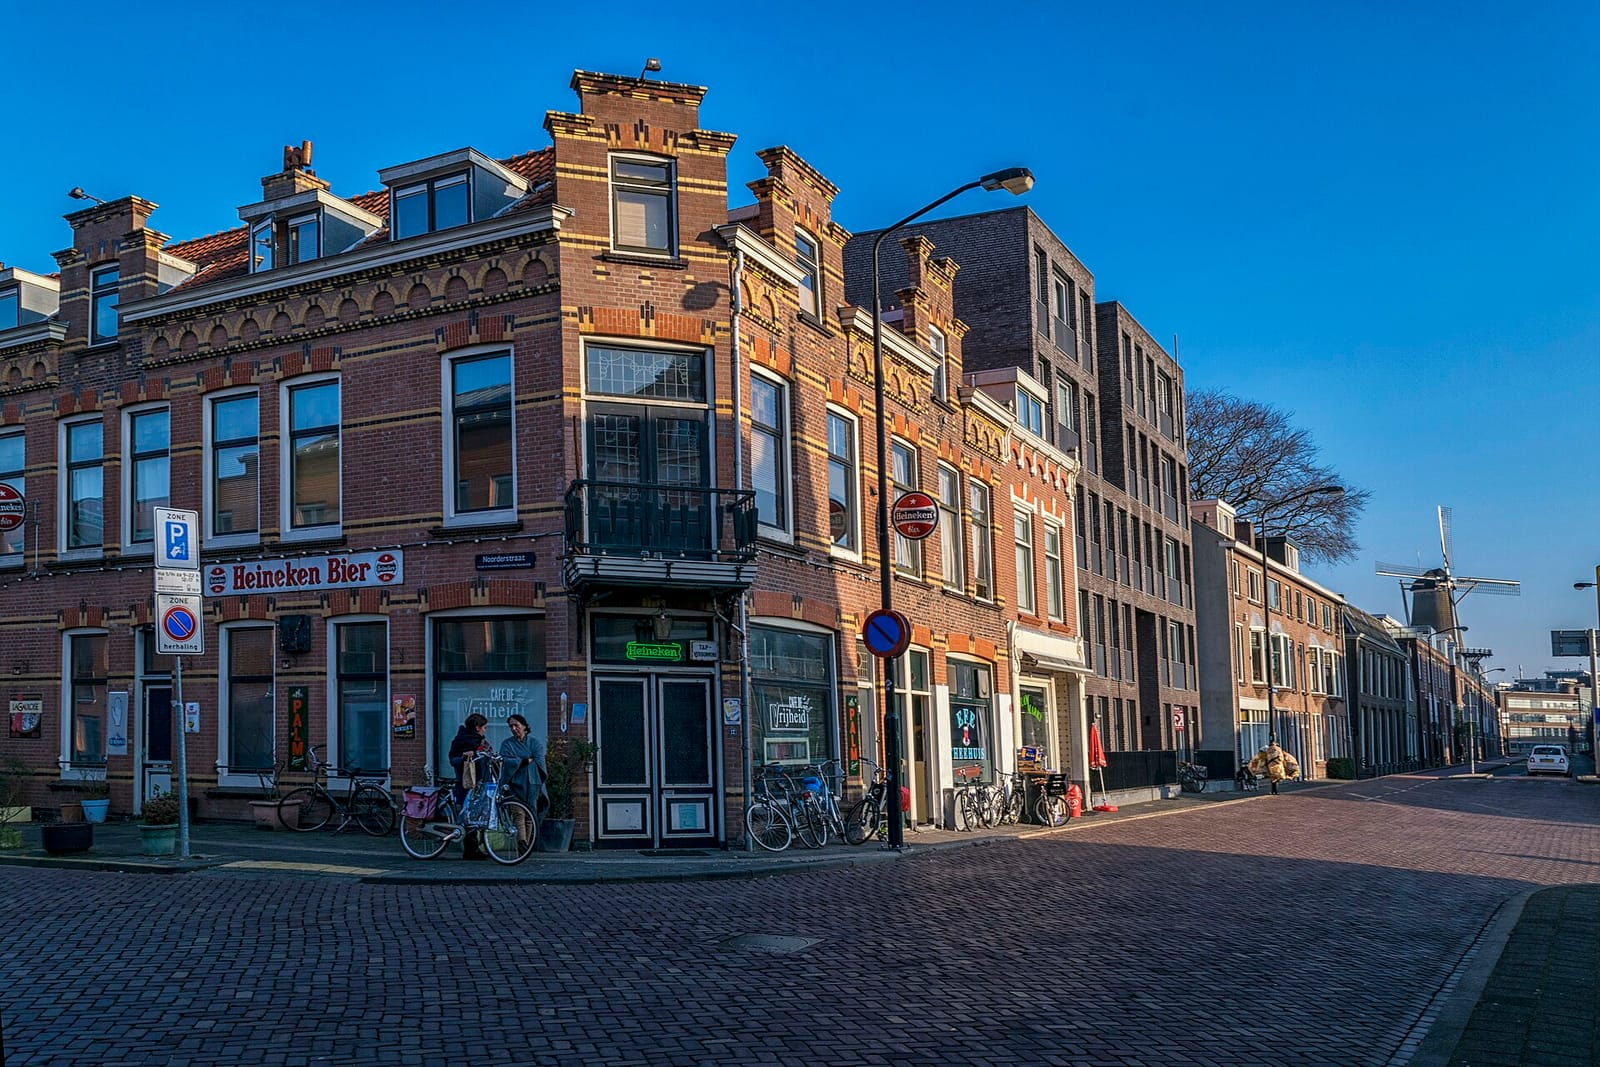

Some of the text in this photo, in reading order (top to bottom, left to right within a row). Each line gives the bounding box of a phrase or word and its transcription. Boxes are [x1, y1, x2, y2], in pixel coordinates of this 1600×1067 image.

[166, 512, 186, 521] ZONE
[896, 511, 934, 521] Heineken
[170, 523, 185, 544] P
[482, 554, 526, 564] Noorderstraat
[232, 557, 372, 591] Heineken Bier
[163, 643, 198, 651] herhaling
[629, 645, 678, 657] Heineken
[461, 696, 519, 718] Vrijheid
[770, 702, 807, 728] Vrijheid
[291, 699, 305, 756] PALM
[848, 707, 858, 761] PALM
[951, 747, 985, 760] HEEHUIS
